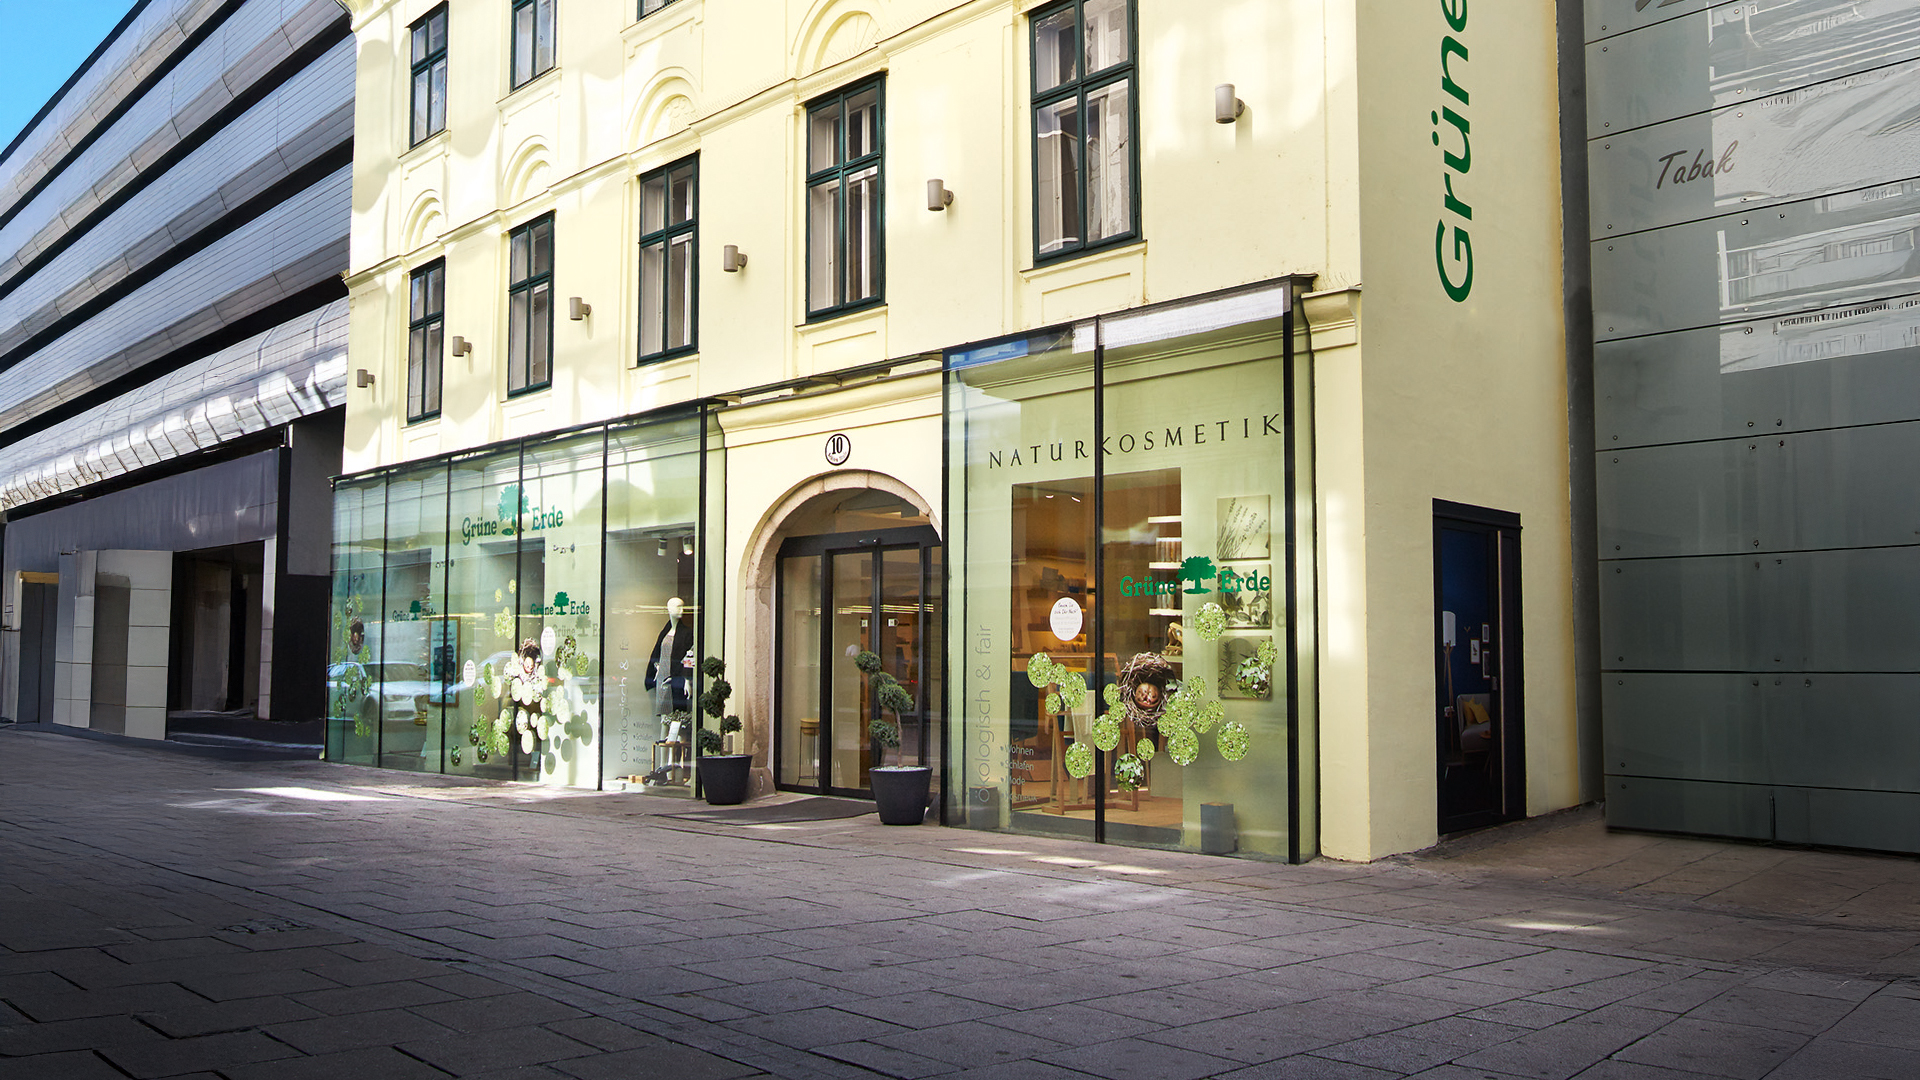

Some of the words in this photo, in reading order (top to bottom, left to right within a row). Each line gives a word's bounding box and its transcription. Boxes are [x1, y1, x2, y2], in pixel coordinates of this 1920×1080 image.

[1657, 140, 1739, 190] Tabak
[832, 436, 843, 455] 10
[989, 413, 1282, 469] NATURKOSMETIK
[462, 516, 498, 546] Grüne
[531, 504, 564, 531] Erde
[1120, 575, 1177, 597] Grüne
[1219, 569, 1270, 594] Erde
[530, 602, 554, 616] Grüne
[570, 600, 590, 615] Erde
[974, 624, 991, 655] fair
[619, 659, 630, 671] &
[975, 664, 991, 680] &
